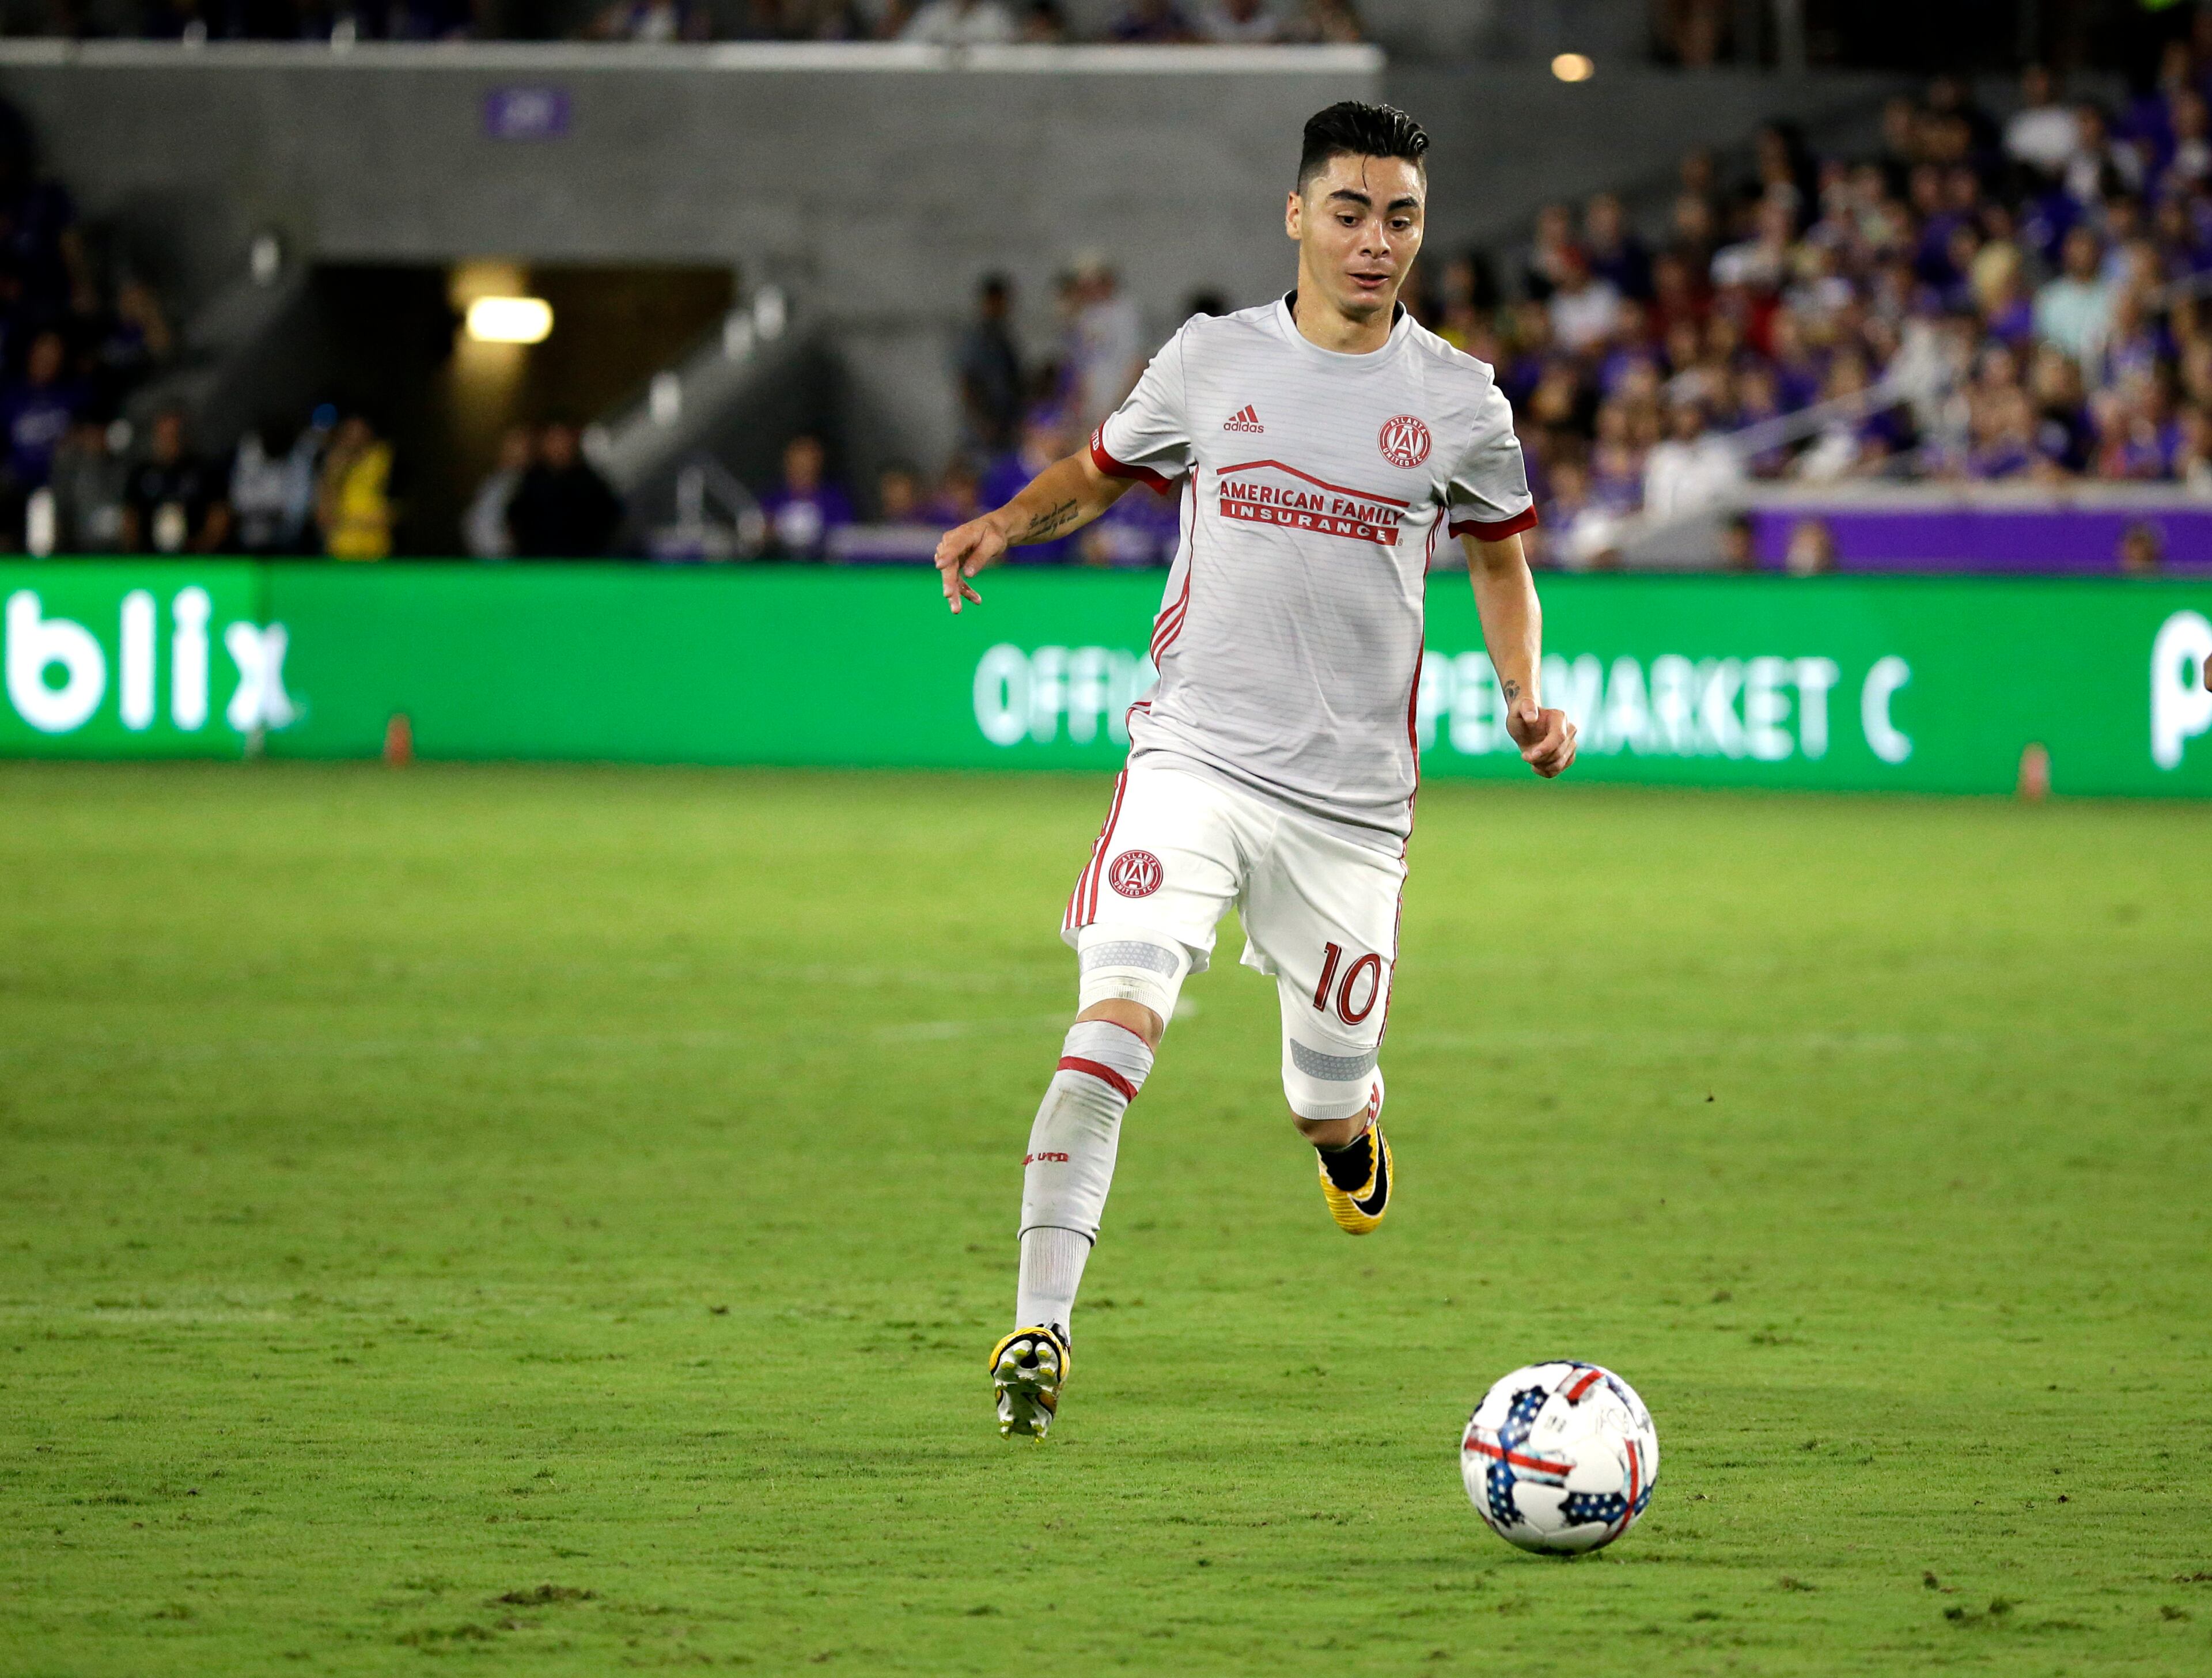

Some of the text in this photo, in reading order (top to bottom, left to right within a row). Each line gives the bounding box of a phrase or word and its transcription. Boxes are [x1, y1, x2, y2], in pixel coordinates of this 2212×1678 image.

[1223, 421, 1264, 433] adidas
[1389, 417, 1426, 434] ATLANTA
[1382, 448, 1422, 466] UNITED FC
[1219, 481, 1405, 526] AMERICAN FAMILY
[1231, 503, 1387, 541] INSURANCE
[5, 586, 290, 733] blix
[1122, 853, 1157, 868] ATLANTA
[1114, 881, 1153, 895] UNITED FC
[1312, 941, 1381, 1026] 10
